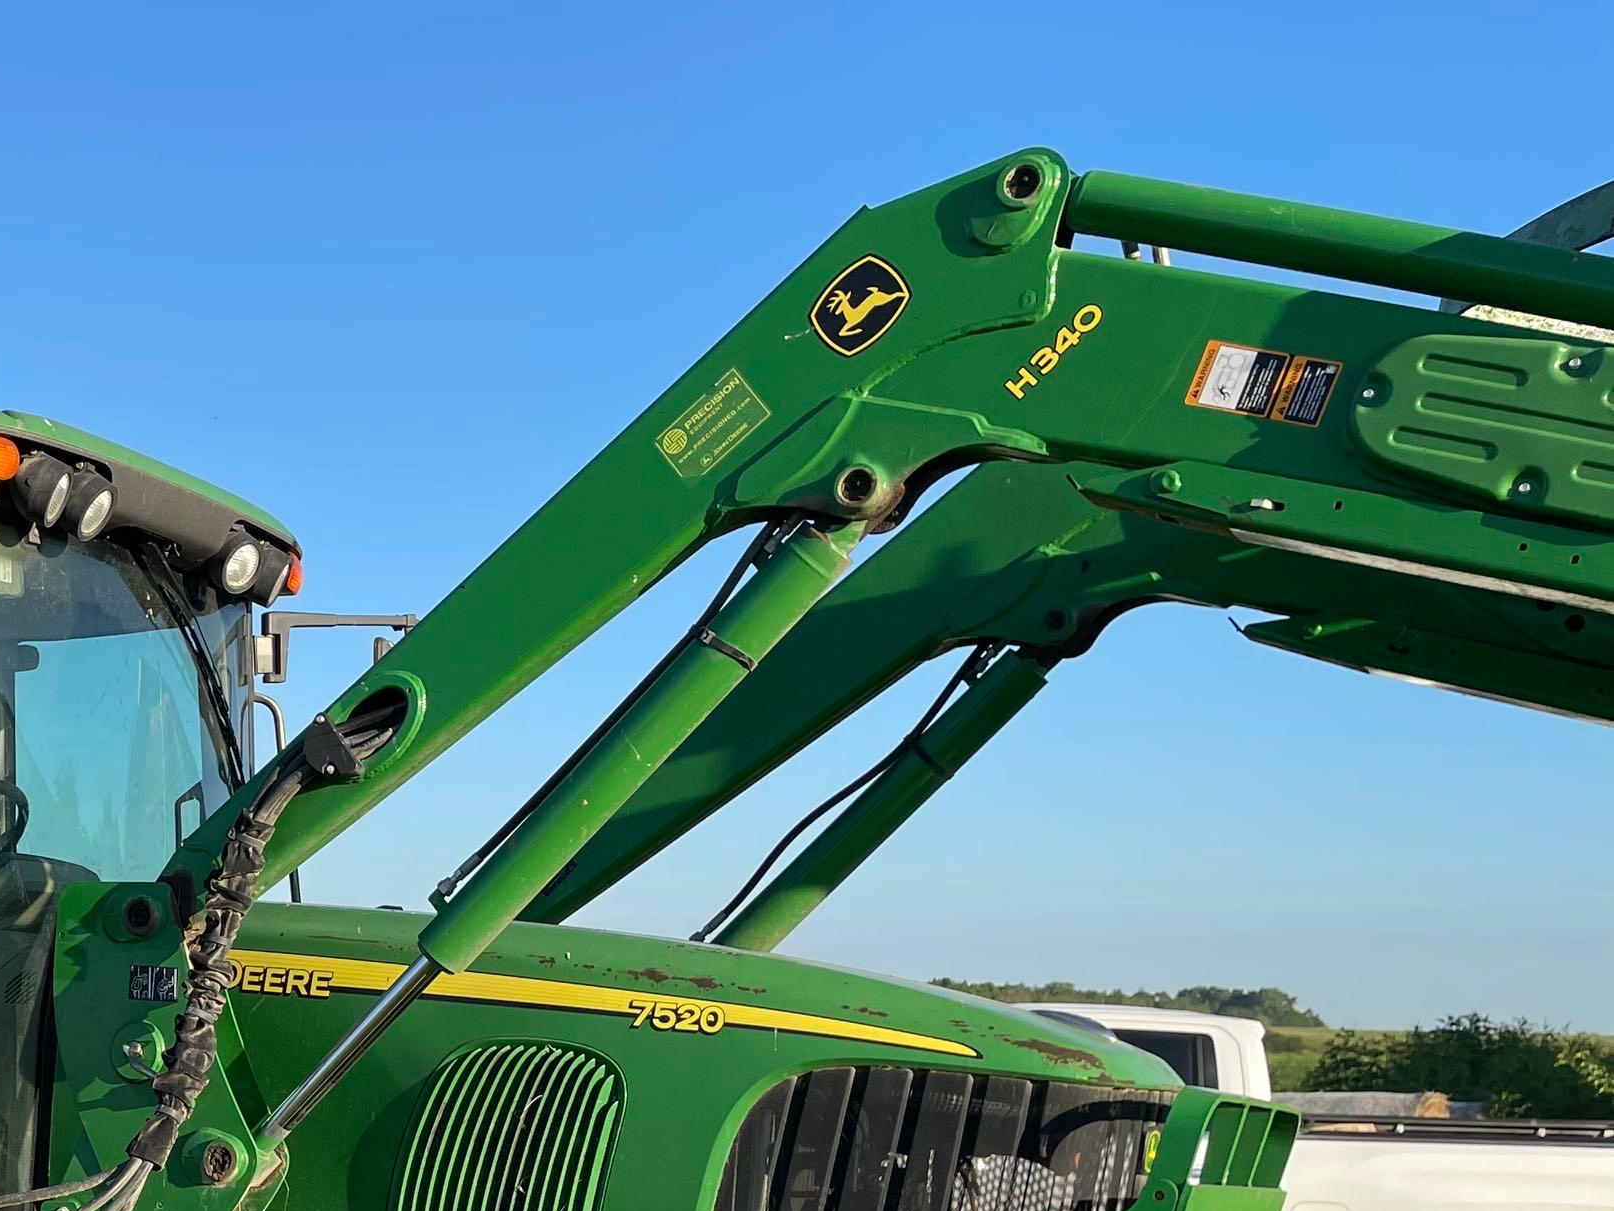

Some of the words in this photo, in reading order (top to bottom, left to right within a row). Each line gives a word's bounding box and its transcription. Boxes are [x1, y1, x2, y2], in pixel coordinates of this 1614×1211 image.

[1004, 366, 1038, 400] H
[1029, 304, 1103, 375] 340
[1195, 348, 1216, 388] WARNING
[1283, 362, 1303, 403] WARNING
[684, 377, 741, 430] PRECISION
[628, 999, 726, 1036] 7520
